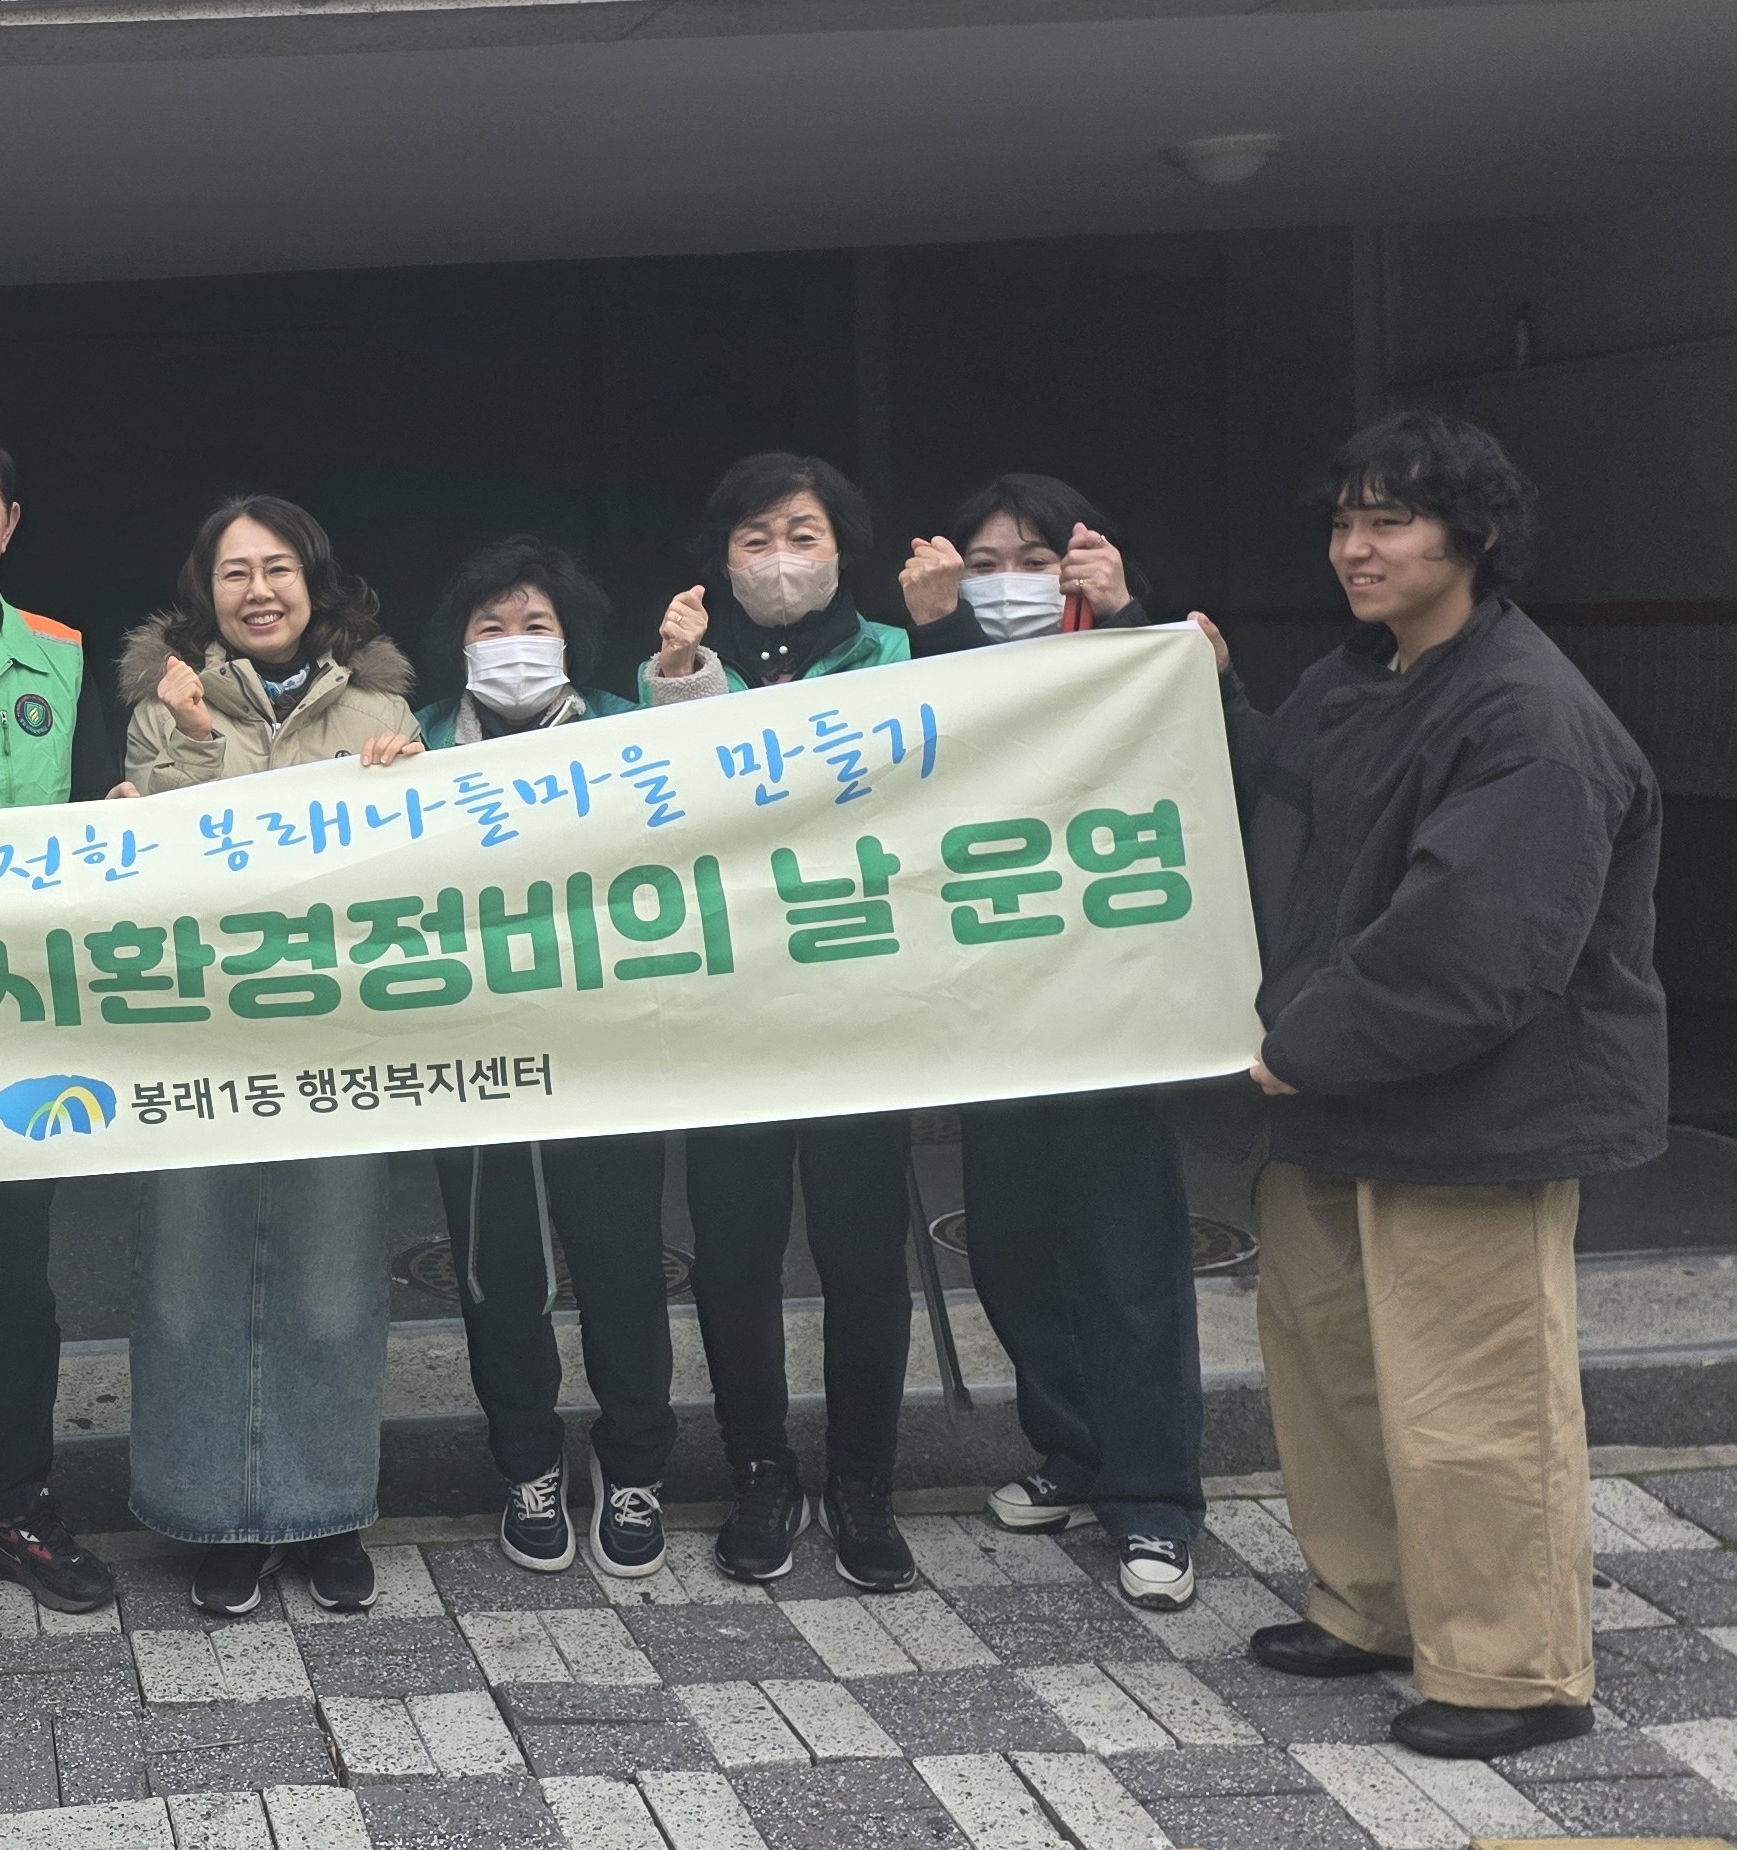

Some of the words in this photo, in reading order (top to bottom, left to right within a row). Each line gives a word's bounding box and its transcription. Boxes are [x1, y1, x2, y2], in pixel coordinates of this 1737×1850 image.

[199, 745, 686, 872] 봉래나들마을
[716, 704, 938, 806] 만들기
[770, 835, 900, 964] 날
[940, 799, 1192, 946] 운영
[131, 1073, 285, 1125] 봉래1동
[296, 1053, 553, 1113] 행정복지센터
